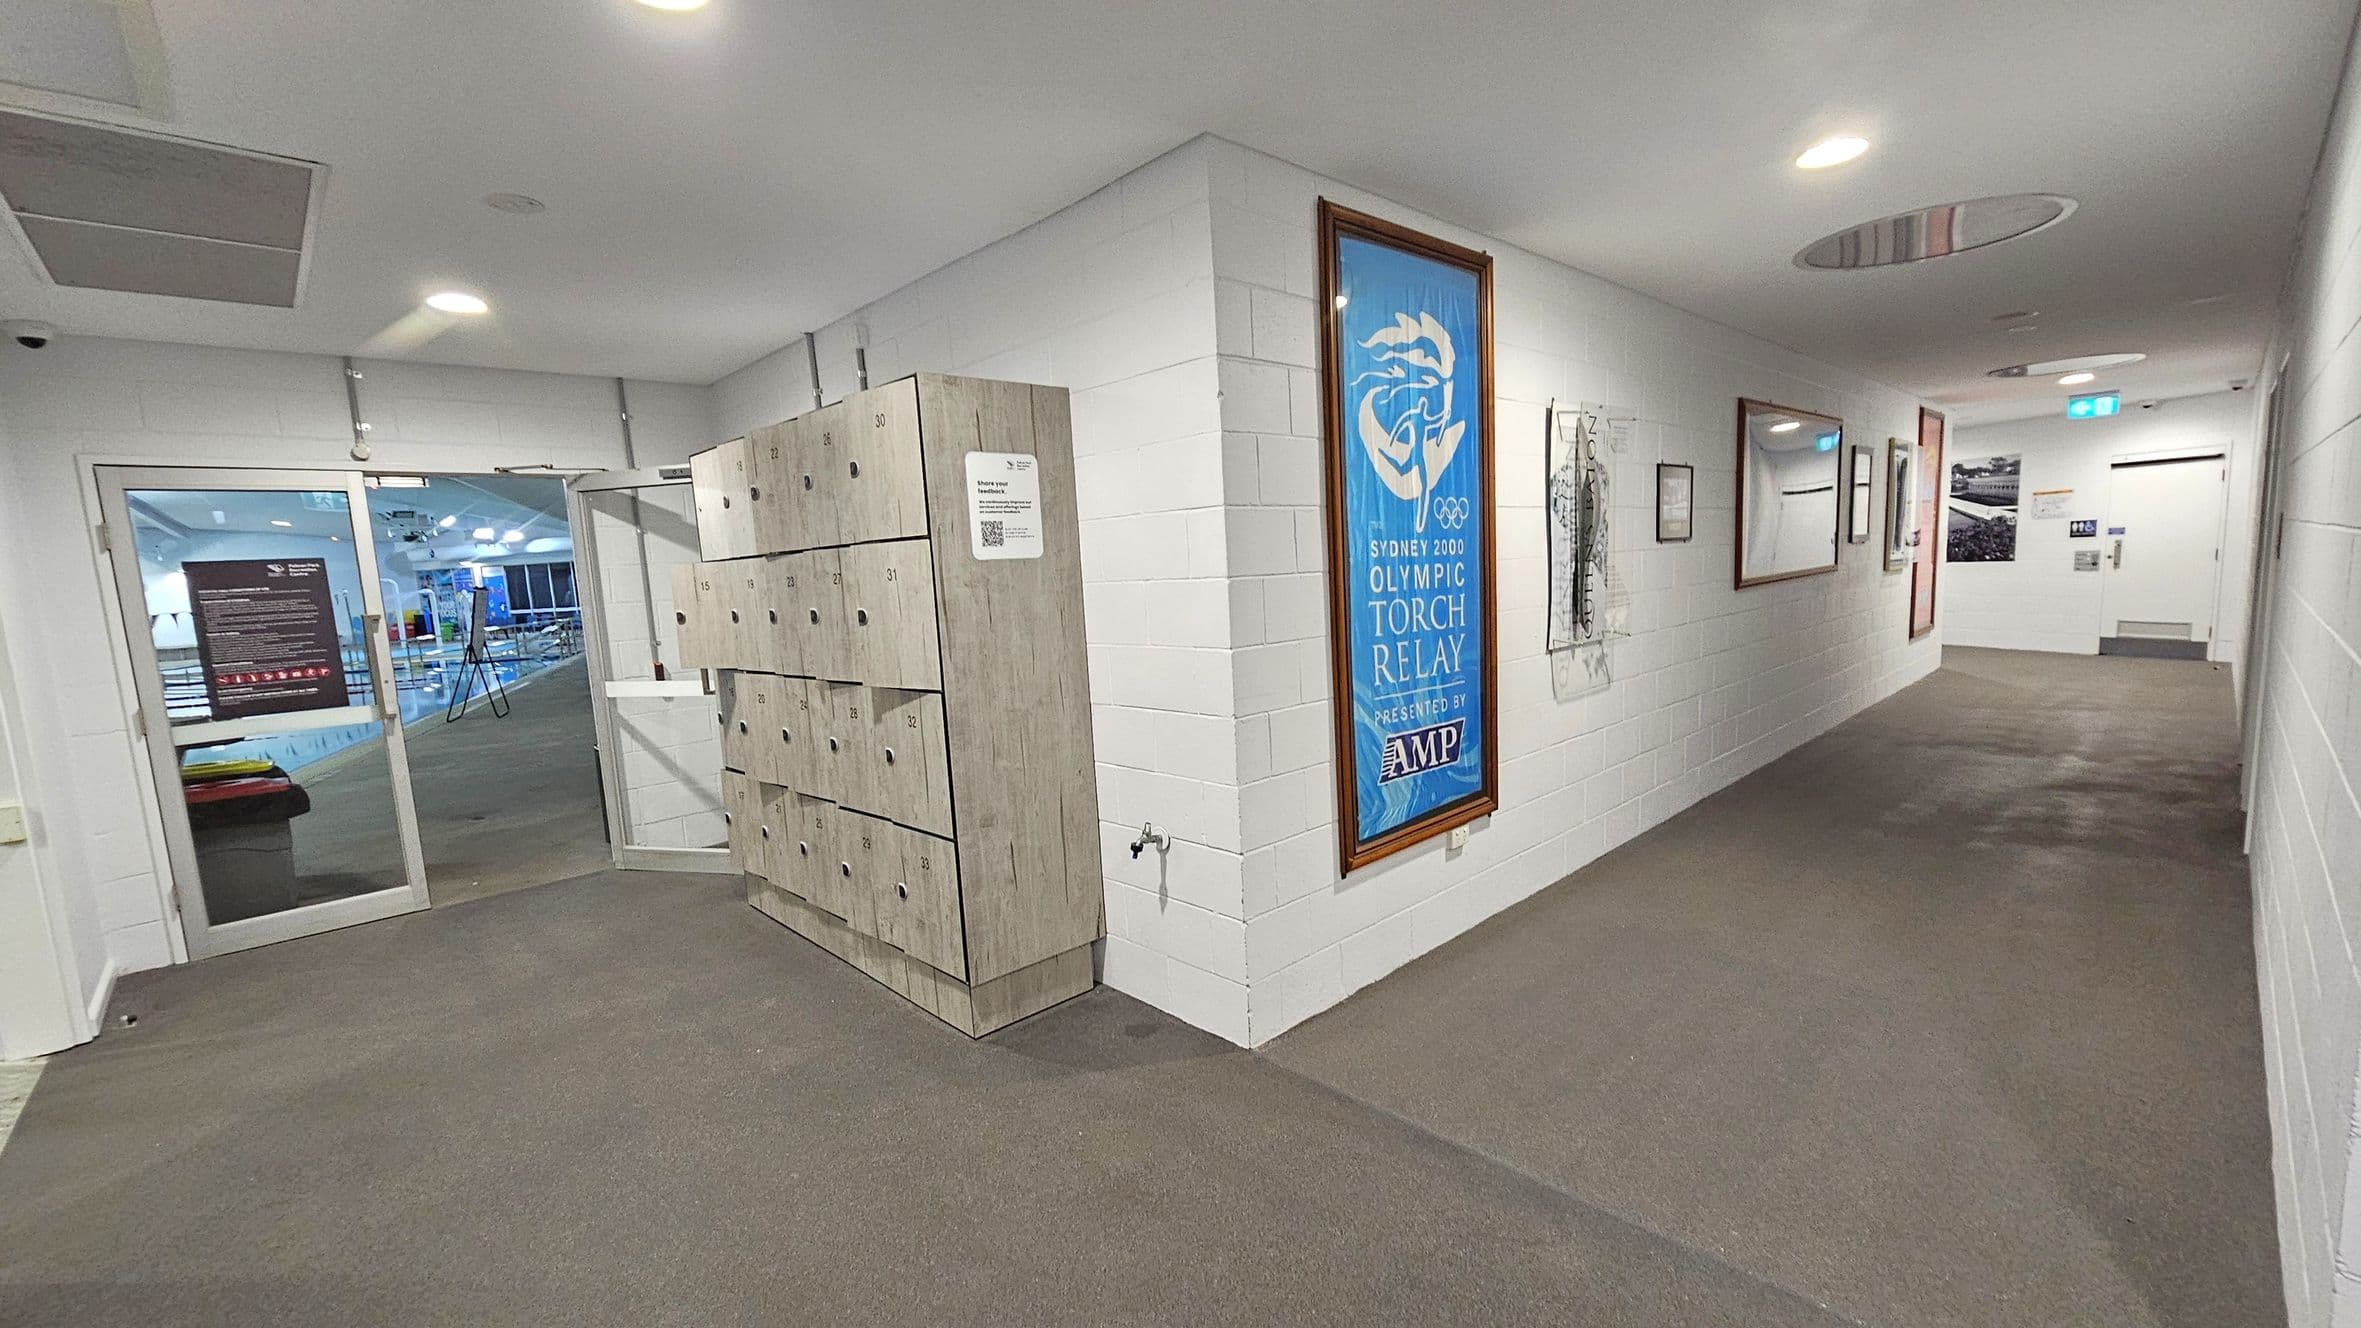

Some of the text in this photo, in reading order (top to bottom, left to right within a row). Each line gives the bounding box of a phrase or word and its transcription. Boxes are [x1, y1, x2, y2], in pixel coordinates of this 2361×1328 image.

[875, 413, 886, 428] 30
[770, 448, 779, 460] 22
[1370, 538, 1464, 558] SYDNEY 2000
[786, 576, 795, 588] 23
[832, 572, 842, 586] 27
[886, 568, 898, 582] 31
[1369, 561, 1465, 593] OLYMPIC
[700, 582, 710, 592] 15
[746, 580, 754, 590] 19
[1368, 593, 1466, 637] TORCH
[1372, 633, 1466, 686] RELAY
[758, 694, 766, 704] 20
[800, 700, 808, 711] 24
[850, 708, 858, 720] 28
[1374, 693, 1466, 726] PRESENTED BY
[908, 715, 917, 729] 32
[1387, 725, 1458, 778] AMP
[775, 804, 782, 814] 21
[862, 837, 872, 850] 29
[920, 856, 930, 870] 33
